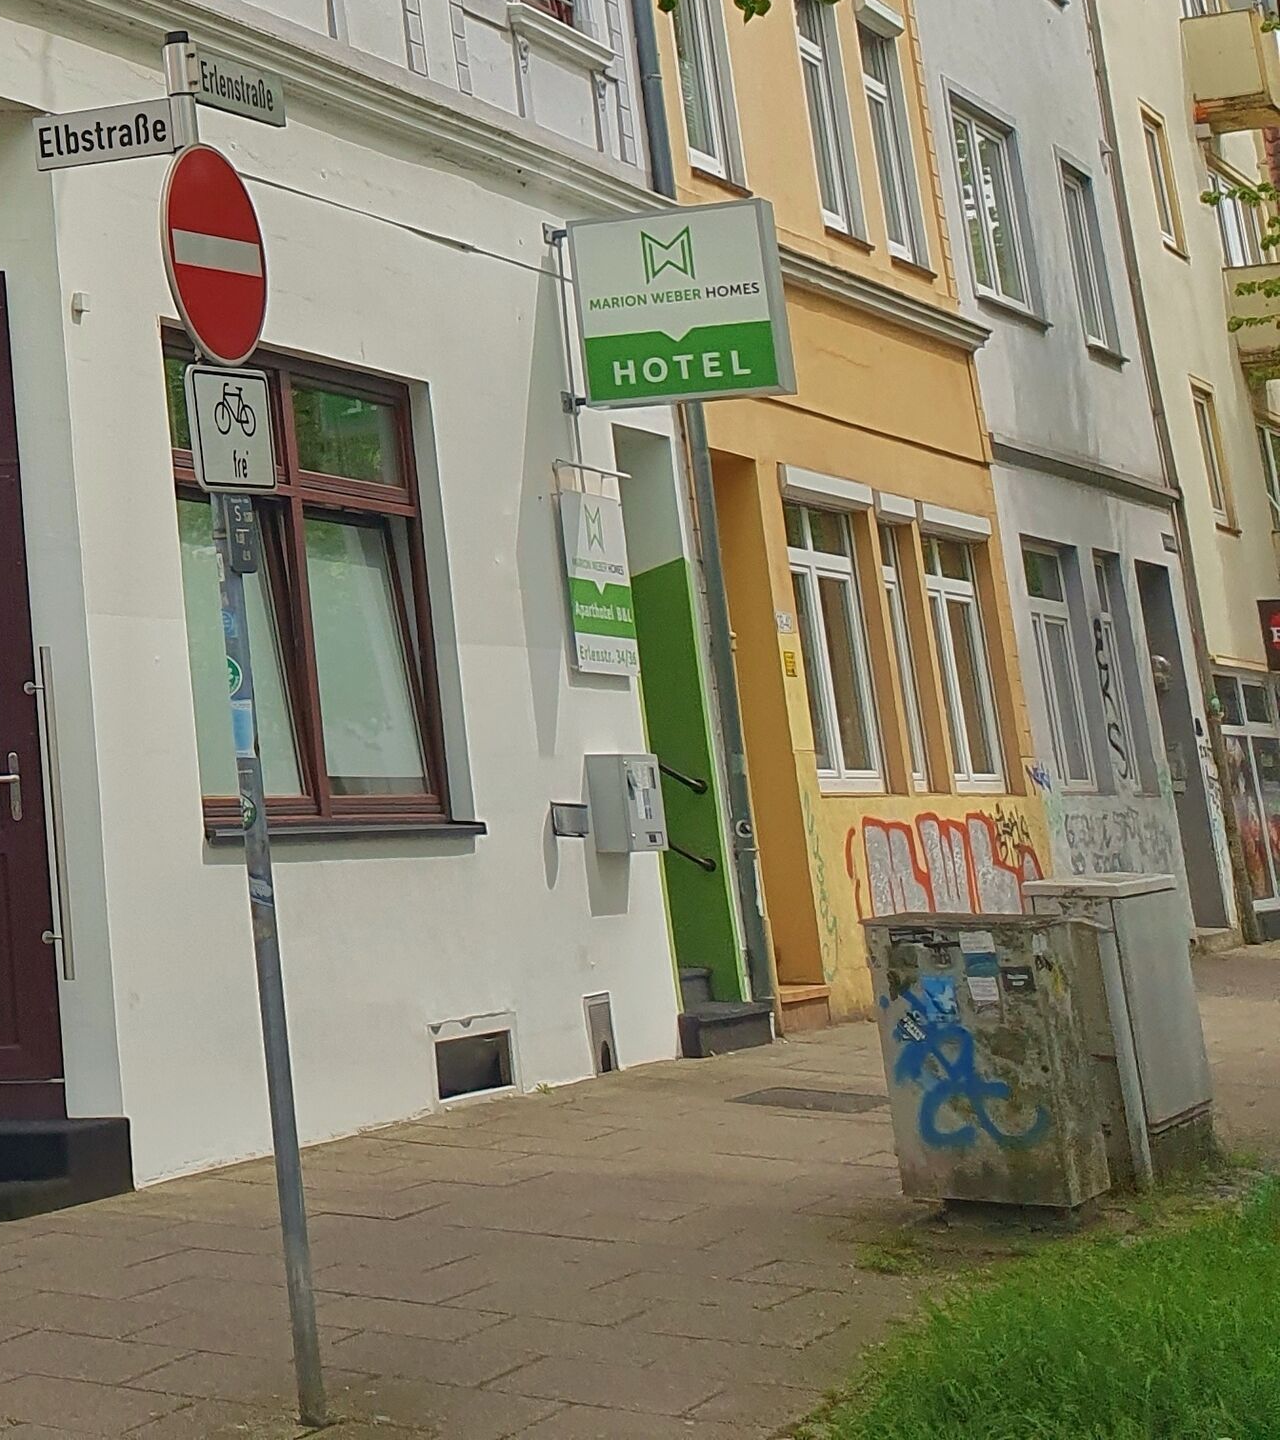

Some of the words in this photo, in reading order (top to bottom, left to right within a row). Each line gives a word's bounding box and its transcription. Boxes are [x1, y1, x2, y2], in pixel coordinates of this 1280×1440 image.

[200, 60, 274, 112] Erlenstraße
[39, 113, 167, 158] Elbstraße
[589, 294, 648, 311] MARION
[651, 288, 701, 305] WEBER
[705, 282, 760, 299] HOMES
[612, 350, 751, 386] HOTEL
[233, 449, 249, 479] fre
